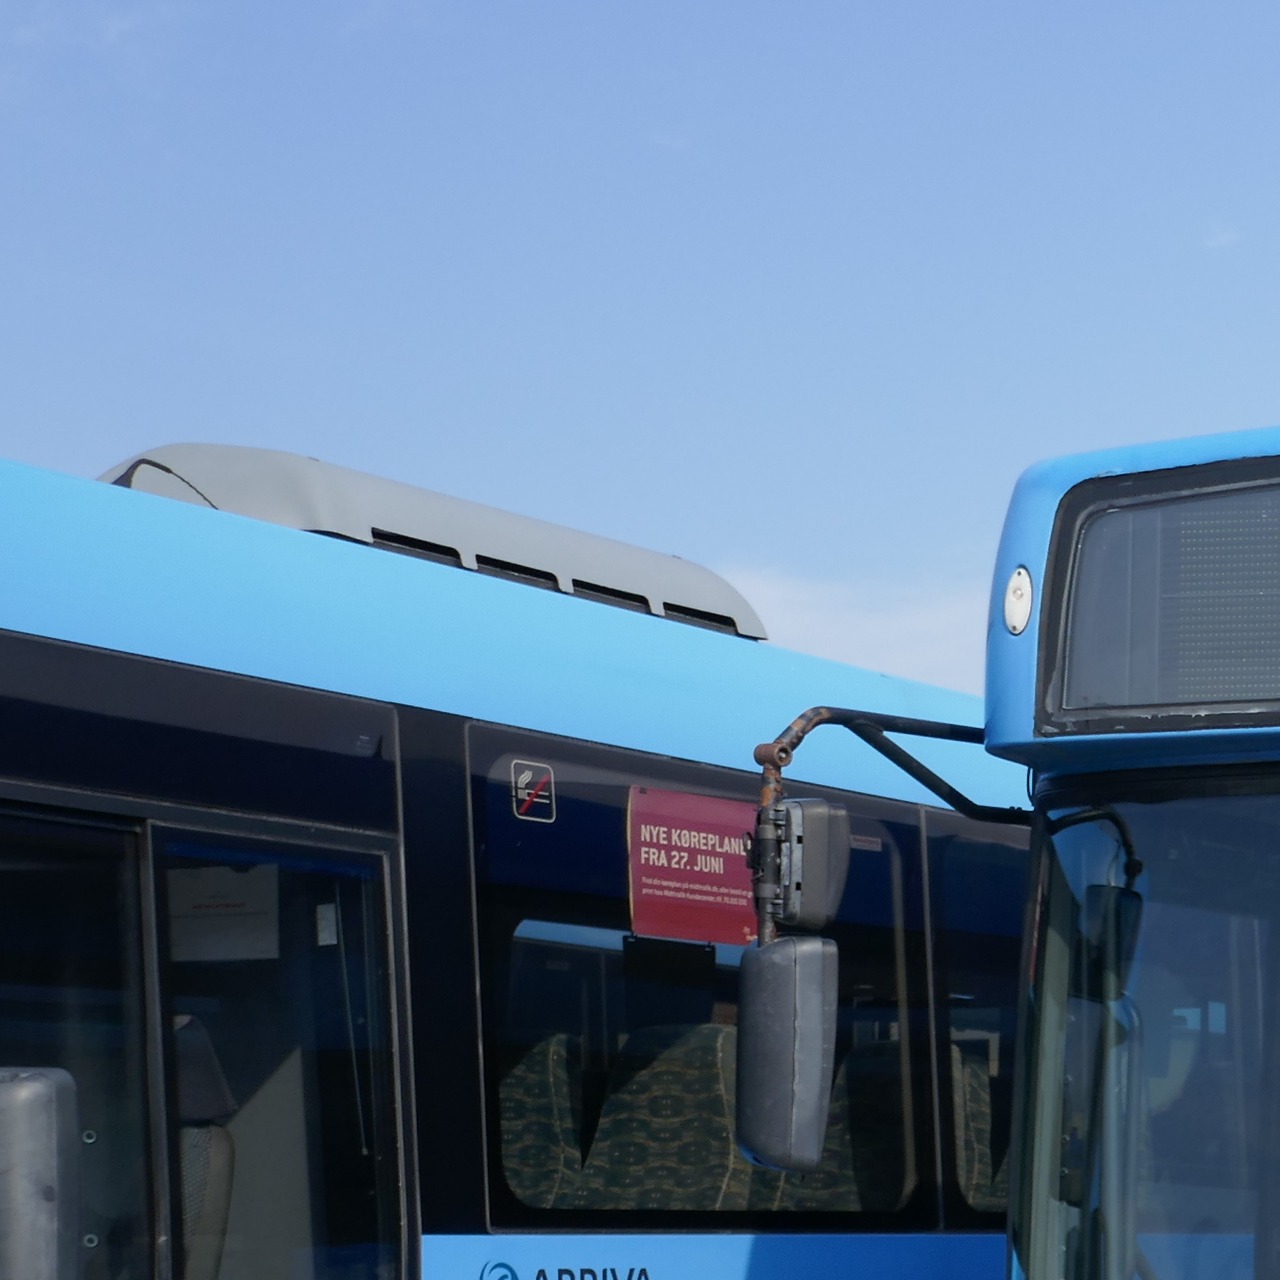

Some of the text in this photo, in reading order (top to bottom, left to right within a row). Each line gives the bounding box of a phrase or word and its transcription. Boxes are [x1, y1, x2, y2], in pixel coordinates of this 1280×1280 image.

[640, 824, 751, 856] NYE KØREPLAN
[640, 847, 724, 875] FRA 27. JUNI
